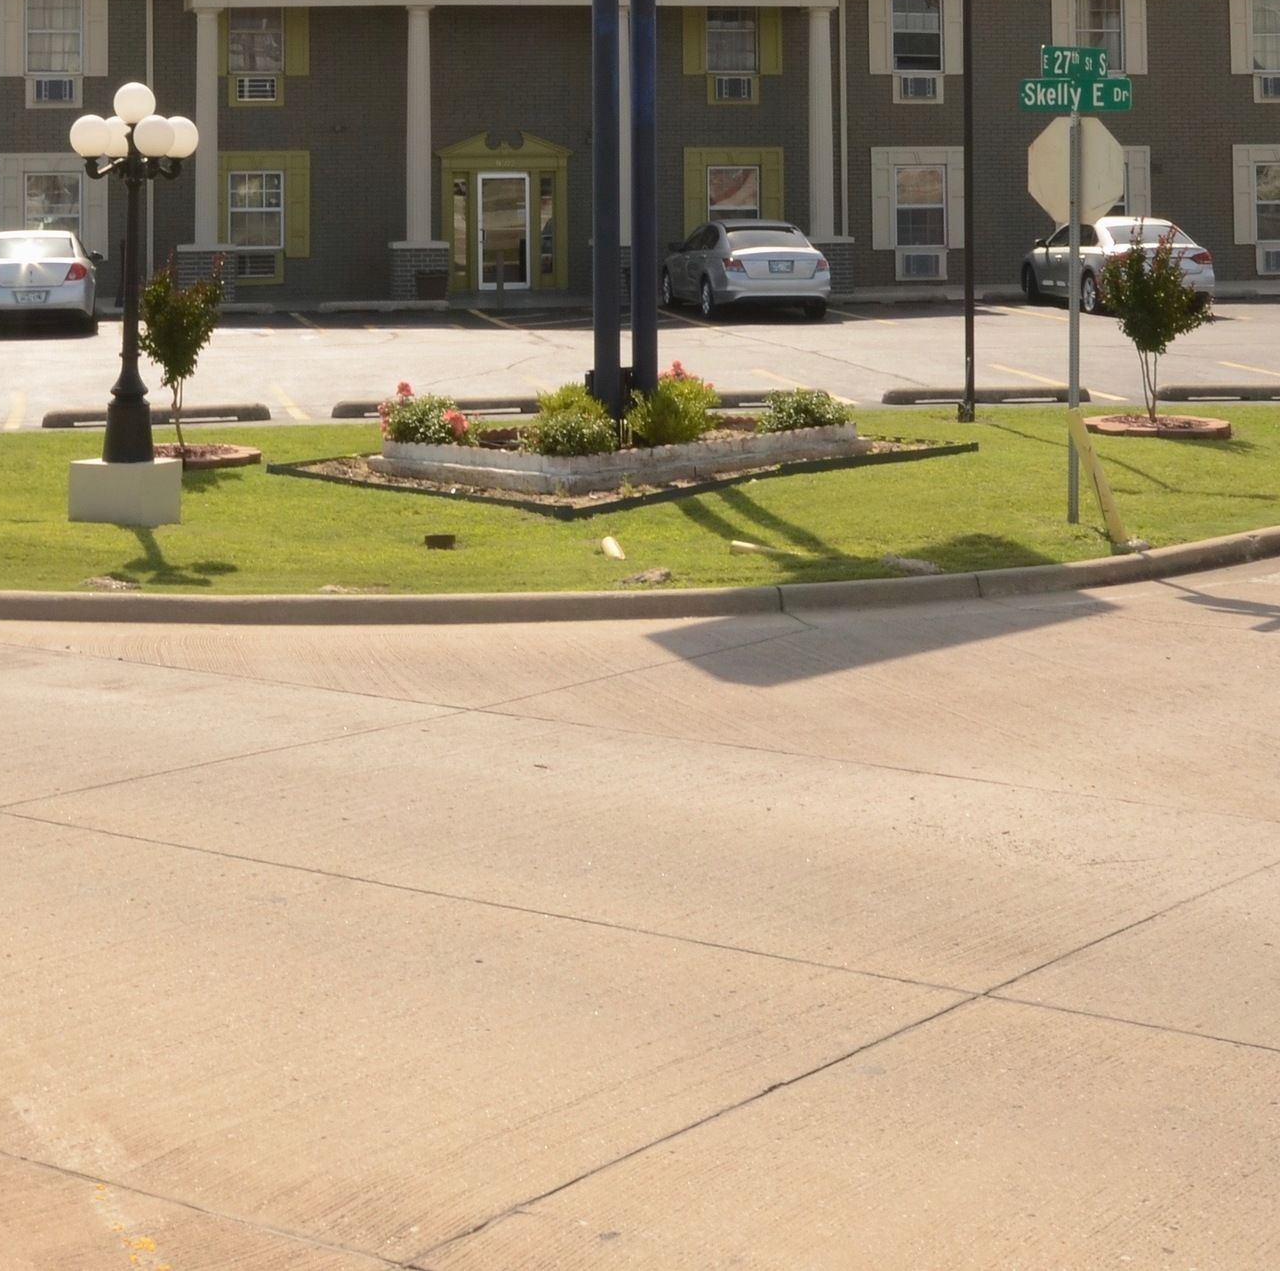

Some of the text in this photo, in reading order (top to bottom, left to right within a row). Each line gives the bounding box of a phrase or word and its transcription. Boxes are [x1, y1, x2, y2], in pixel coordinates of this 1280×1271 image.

[1044, 50, 1107, 76] E 27th St S
[1023, 82, 1130, 112] Skelly E Dr
